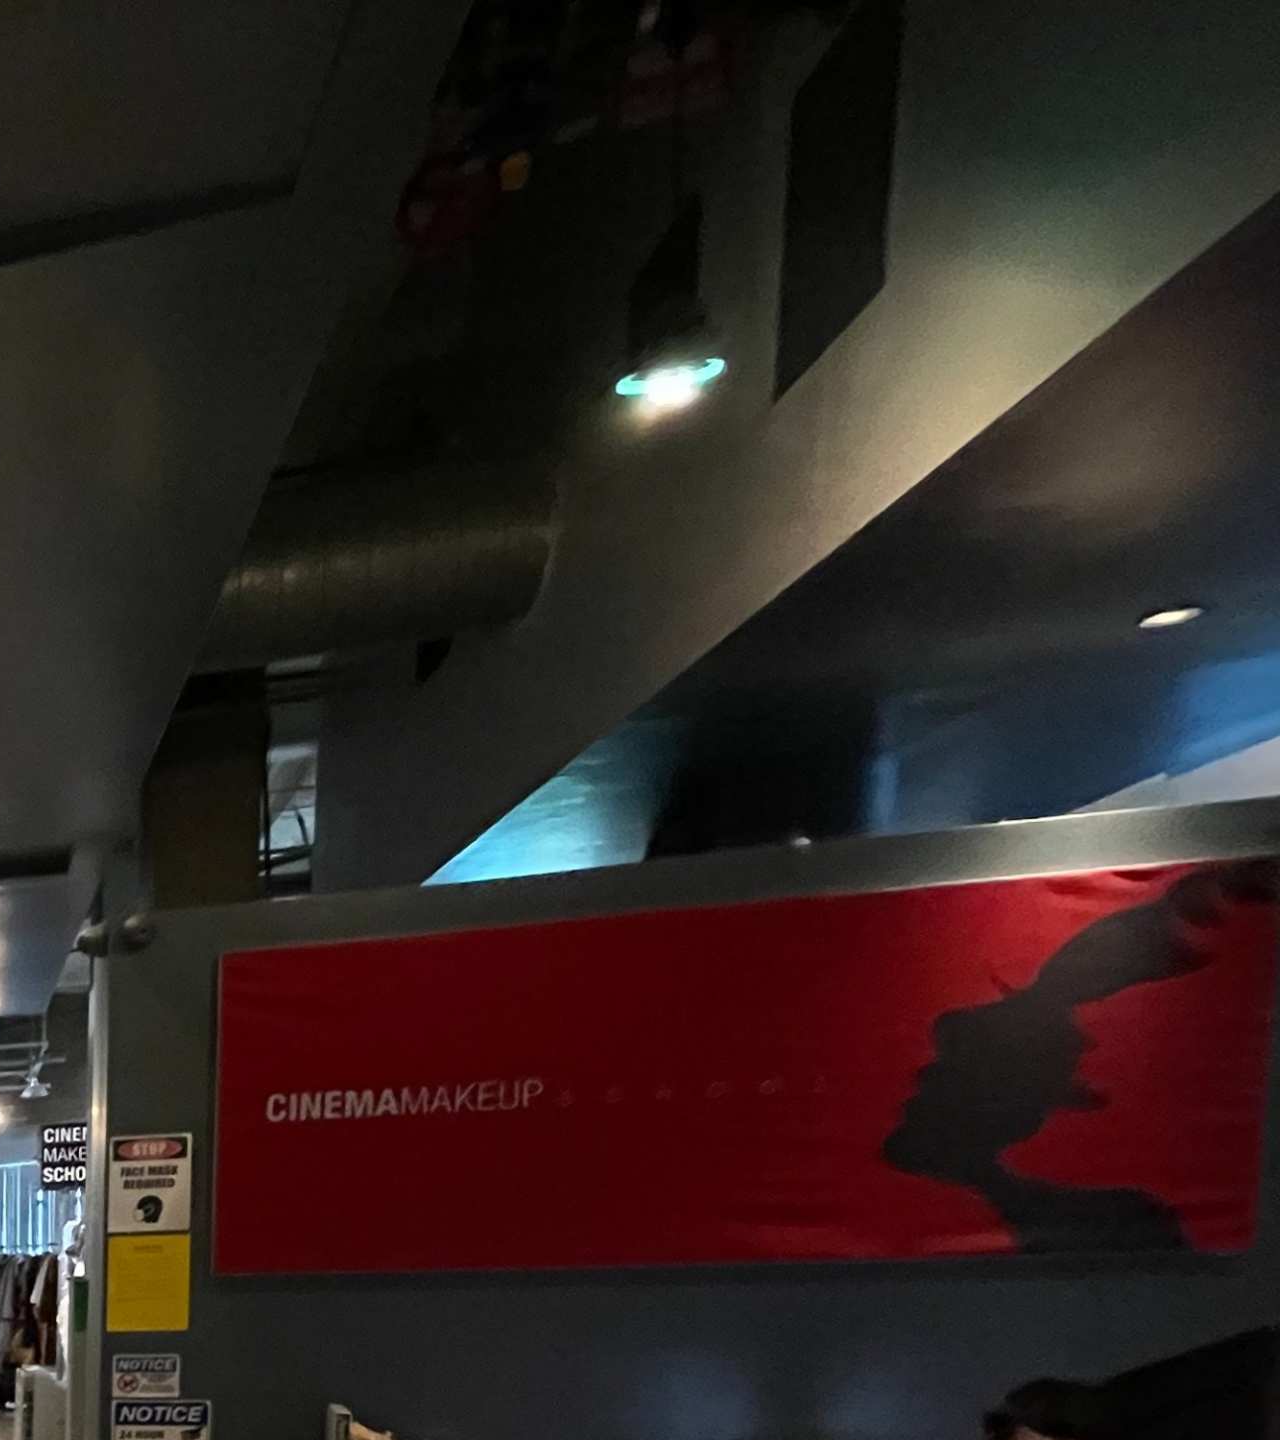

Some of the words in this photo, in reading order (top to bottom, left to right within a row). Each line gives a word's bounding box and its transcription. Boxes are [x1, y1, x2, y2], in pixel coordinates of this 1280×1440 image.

[132, 1142, 167, 1156] STOP
[42, 1166, 87, 1183] SCHO
[119, 1360, 174, 1370] NOTICE
[120, 1406, 204, 1422] NOTICE
